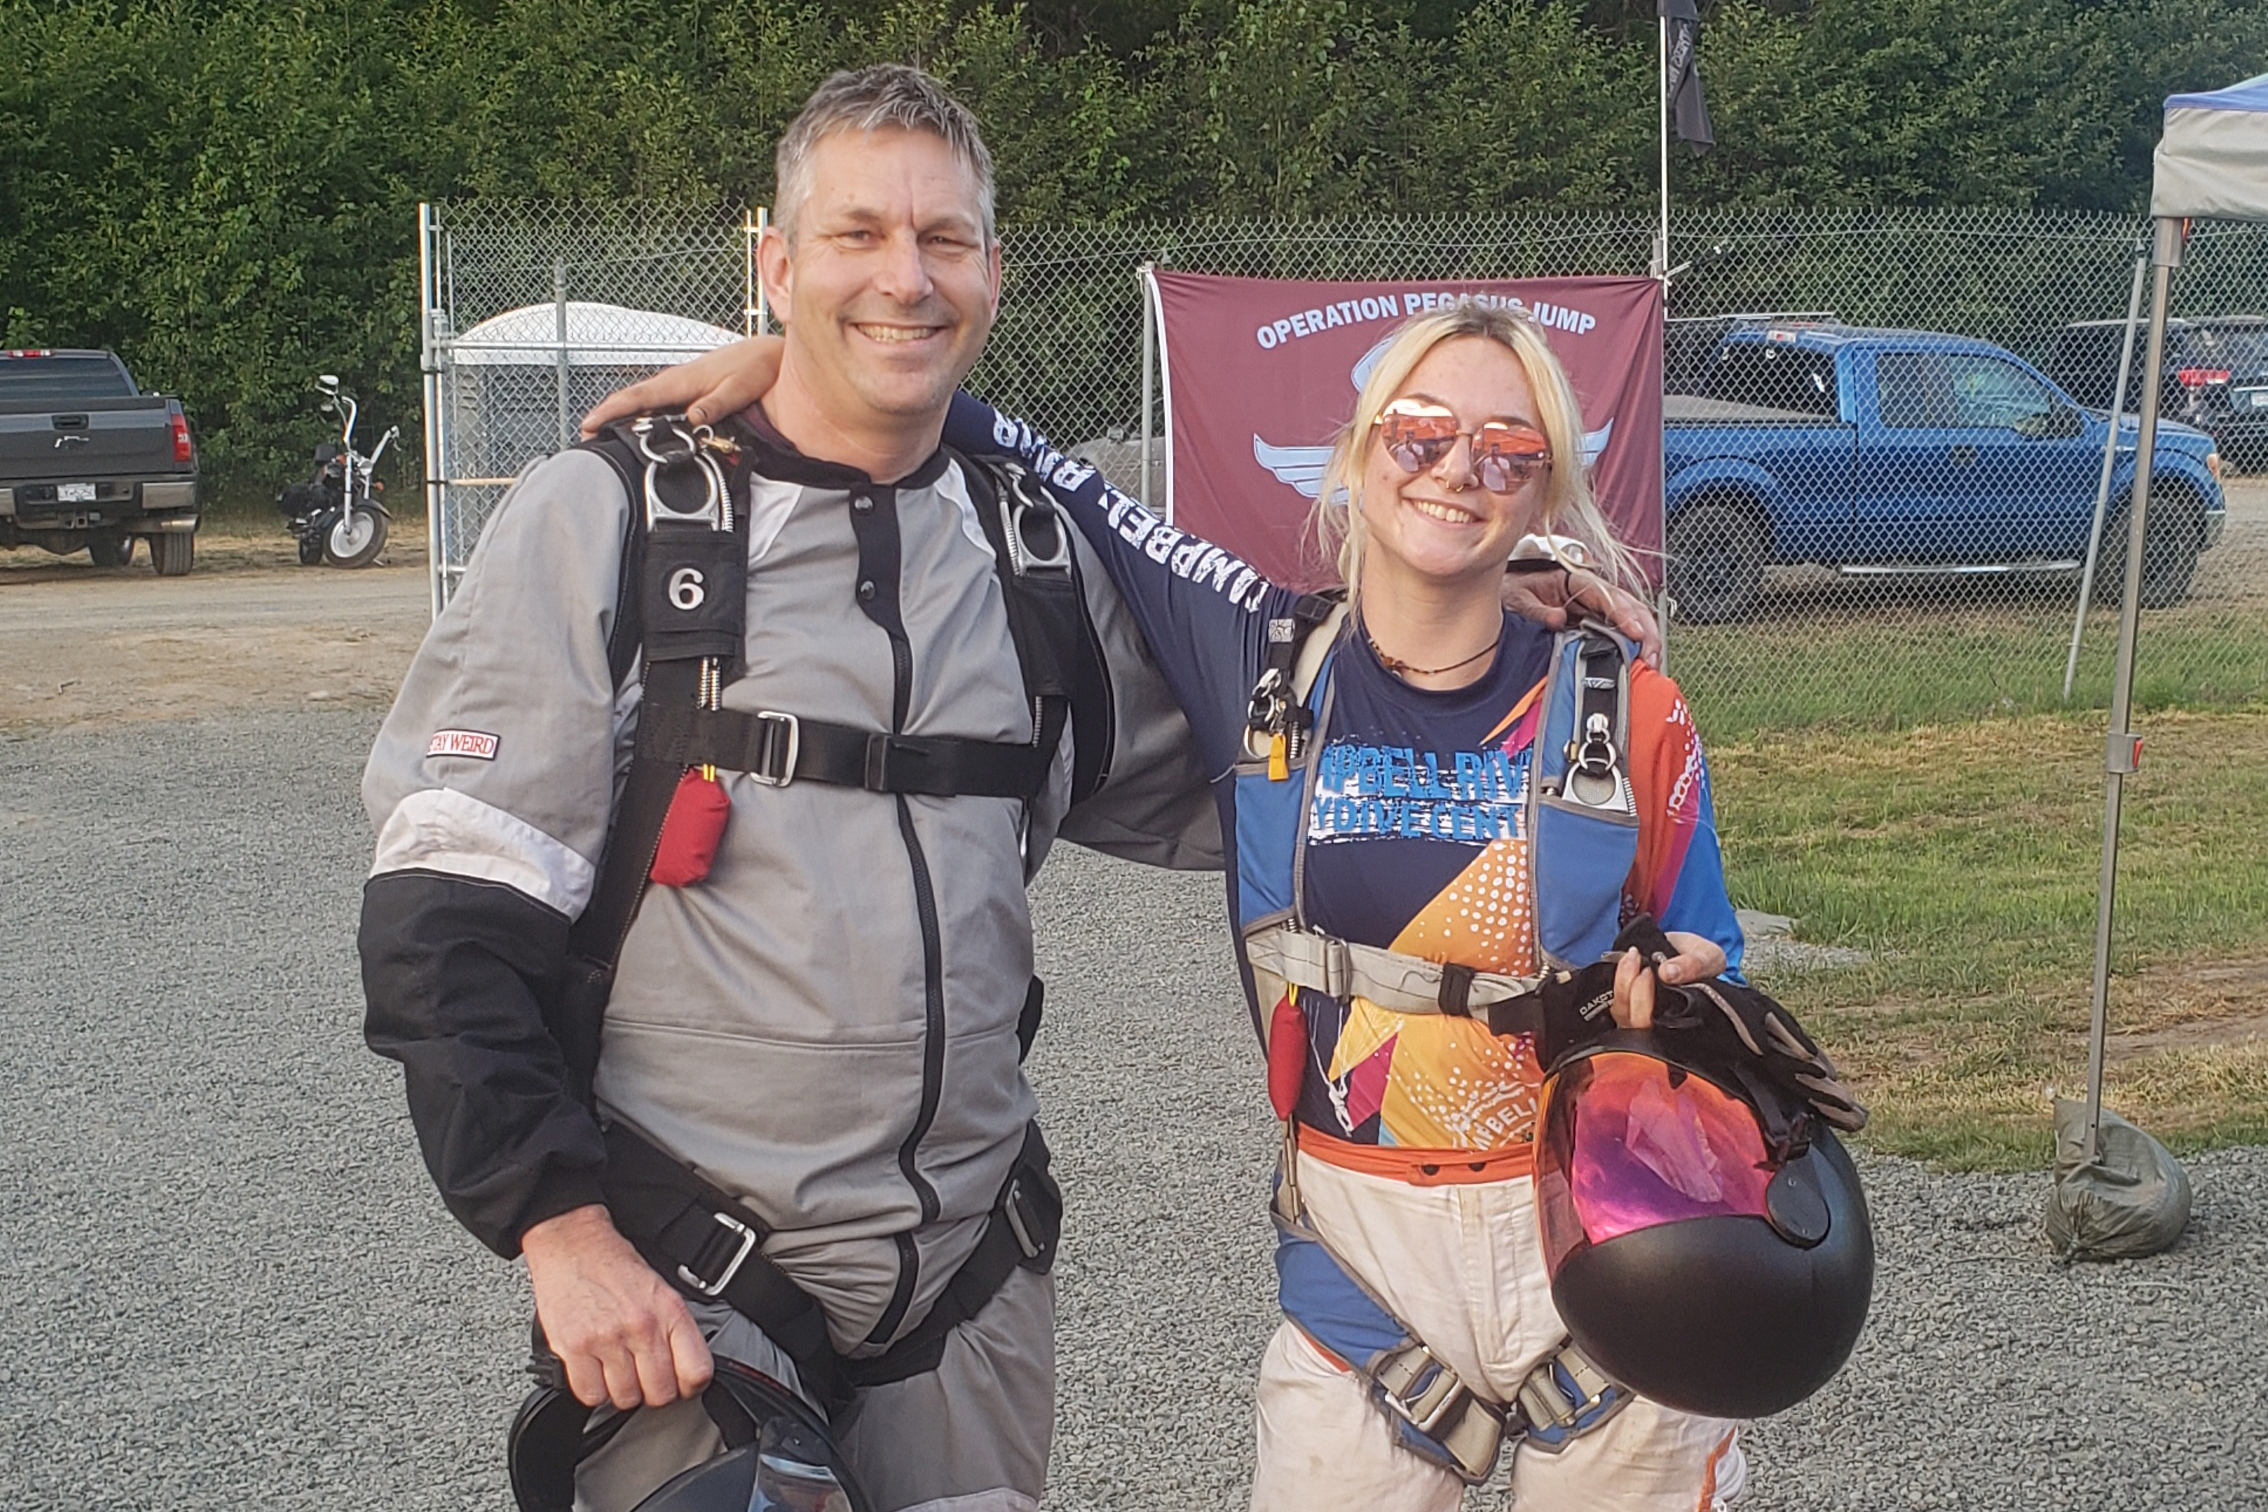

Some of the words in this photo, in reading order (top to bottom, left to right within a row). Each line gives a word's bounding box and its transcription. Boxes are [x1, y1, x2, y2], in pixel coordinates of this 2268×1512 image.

[1256, 294, 1399, 349] OPERATION
[1527, 301, 1596, 335] JUMP
[669, 568, 704, 610] 6
[450, 733, 495, 755] WEIRD
